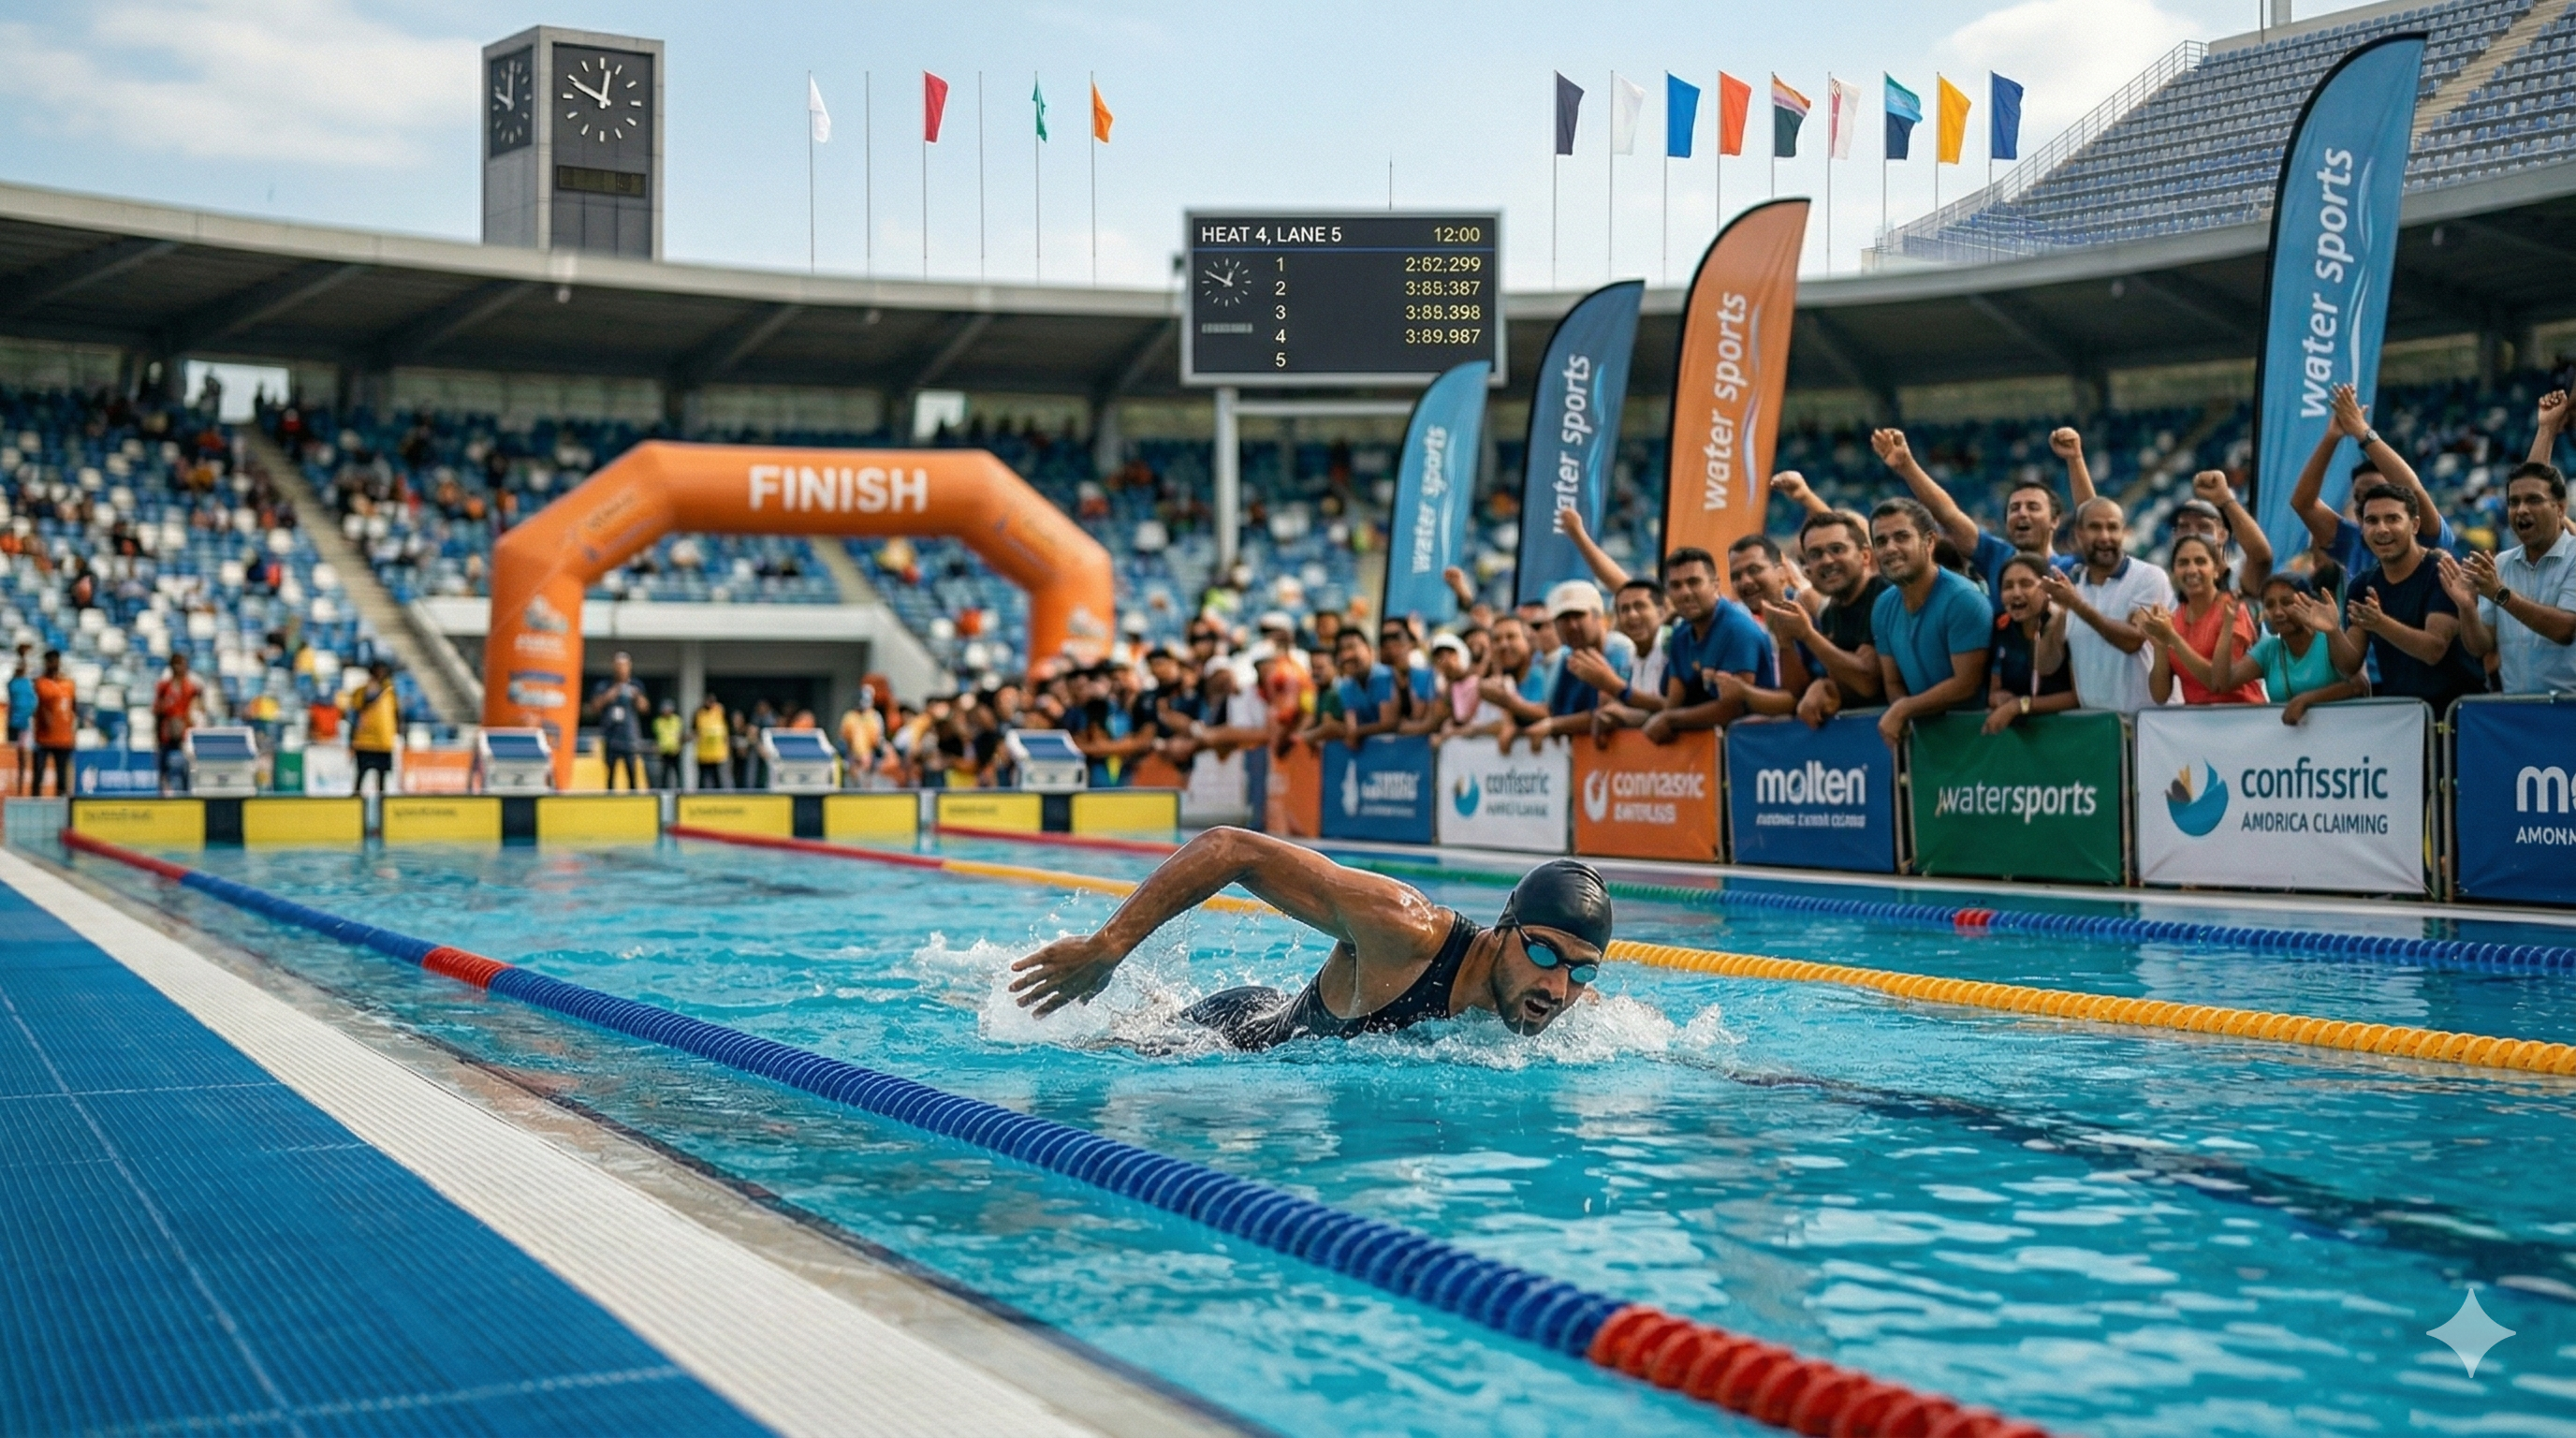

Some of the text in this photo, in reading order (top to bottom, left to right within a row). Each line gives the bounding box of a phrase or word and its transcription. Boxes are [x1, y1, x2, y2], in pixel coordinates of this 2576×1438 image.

[1202, 226, 1481, 245] HEAT 4, LANE 5 12:00
[1276, 257, 1283, 271] 1
[2301, 147, 2354, 418] water sports
[1275, 280, 1286, 296] 2
[1275, 304, 1286, 320] 3
[1275, 329, 1481, 345] 4 3:89.987
[1275, 352, 1286, 368] 5
[1561, 354, 1592, 446] sports
[1704, 292, 1748, 510] water sports
[750, 465, 927, 513] FINISH
[1756, 760, 1866, 804] molten
[2241, 756, 2389, 800] confissric
[2516, 766, 2576, 814] m
[1936, 780, 2098, 825] watersports
[2241, 812, 2389, 835] AMORICA CLAIMING
